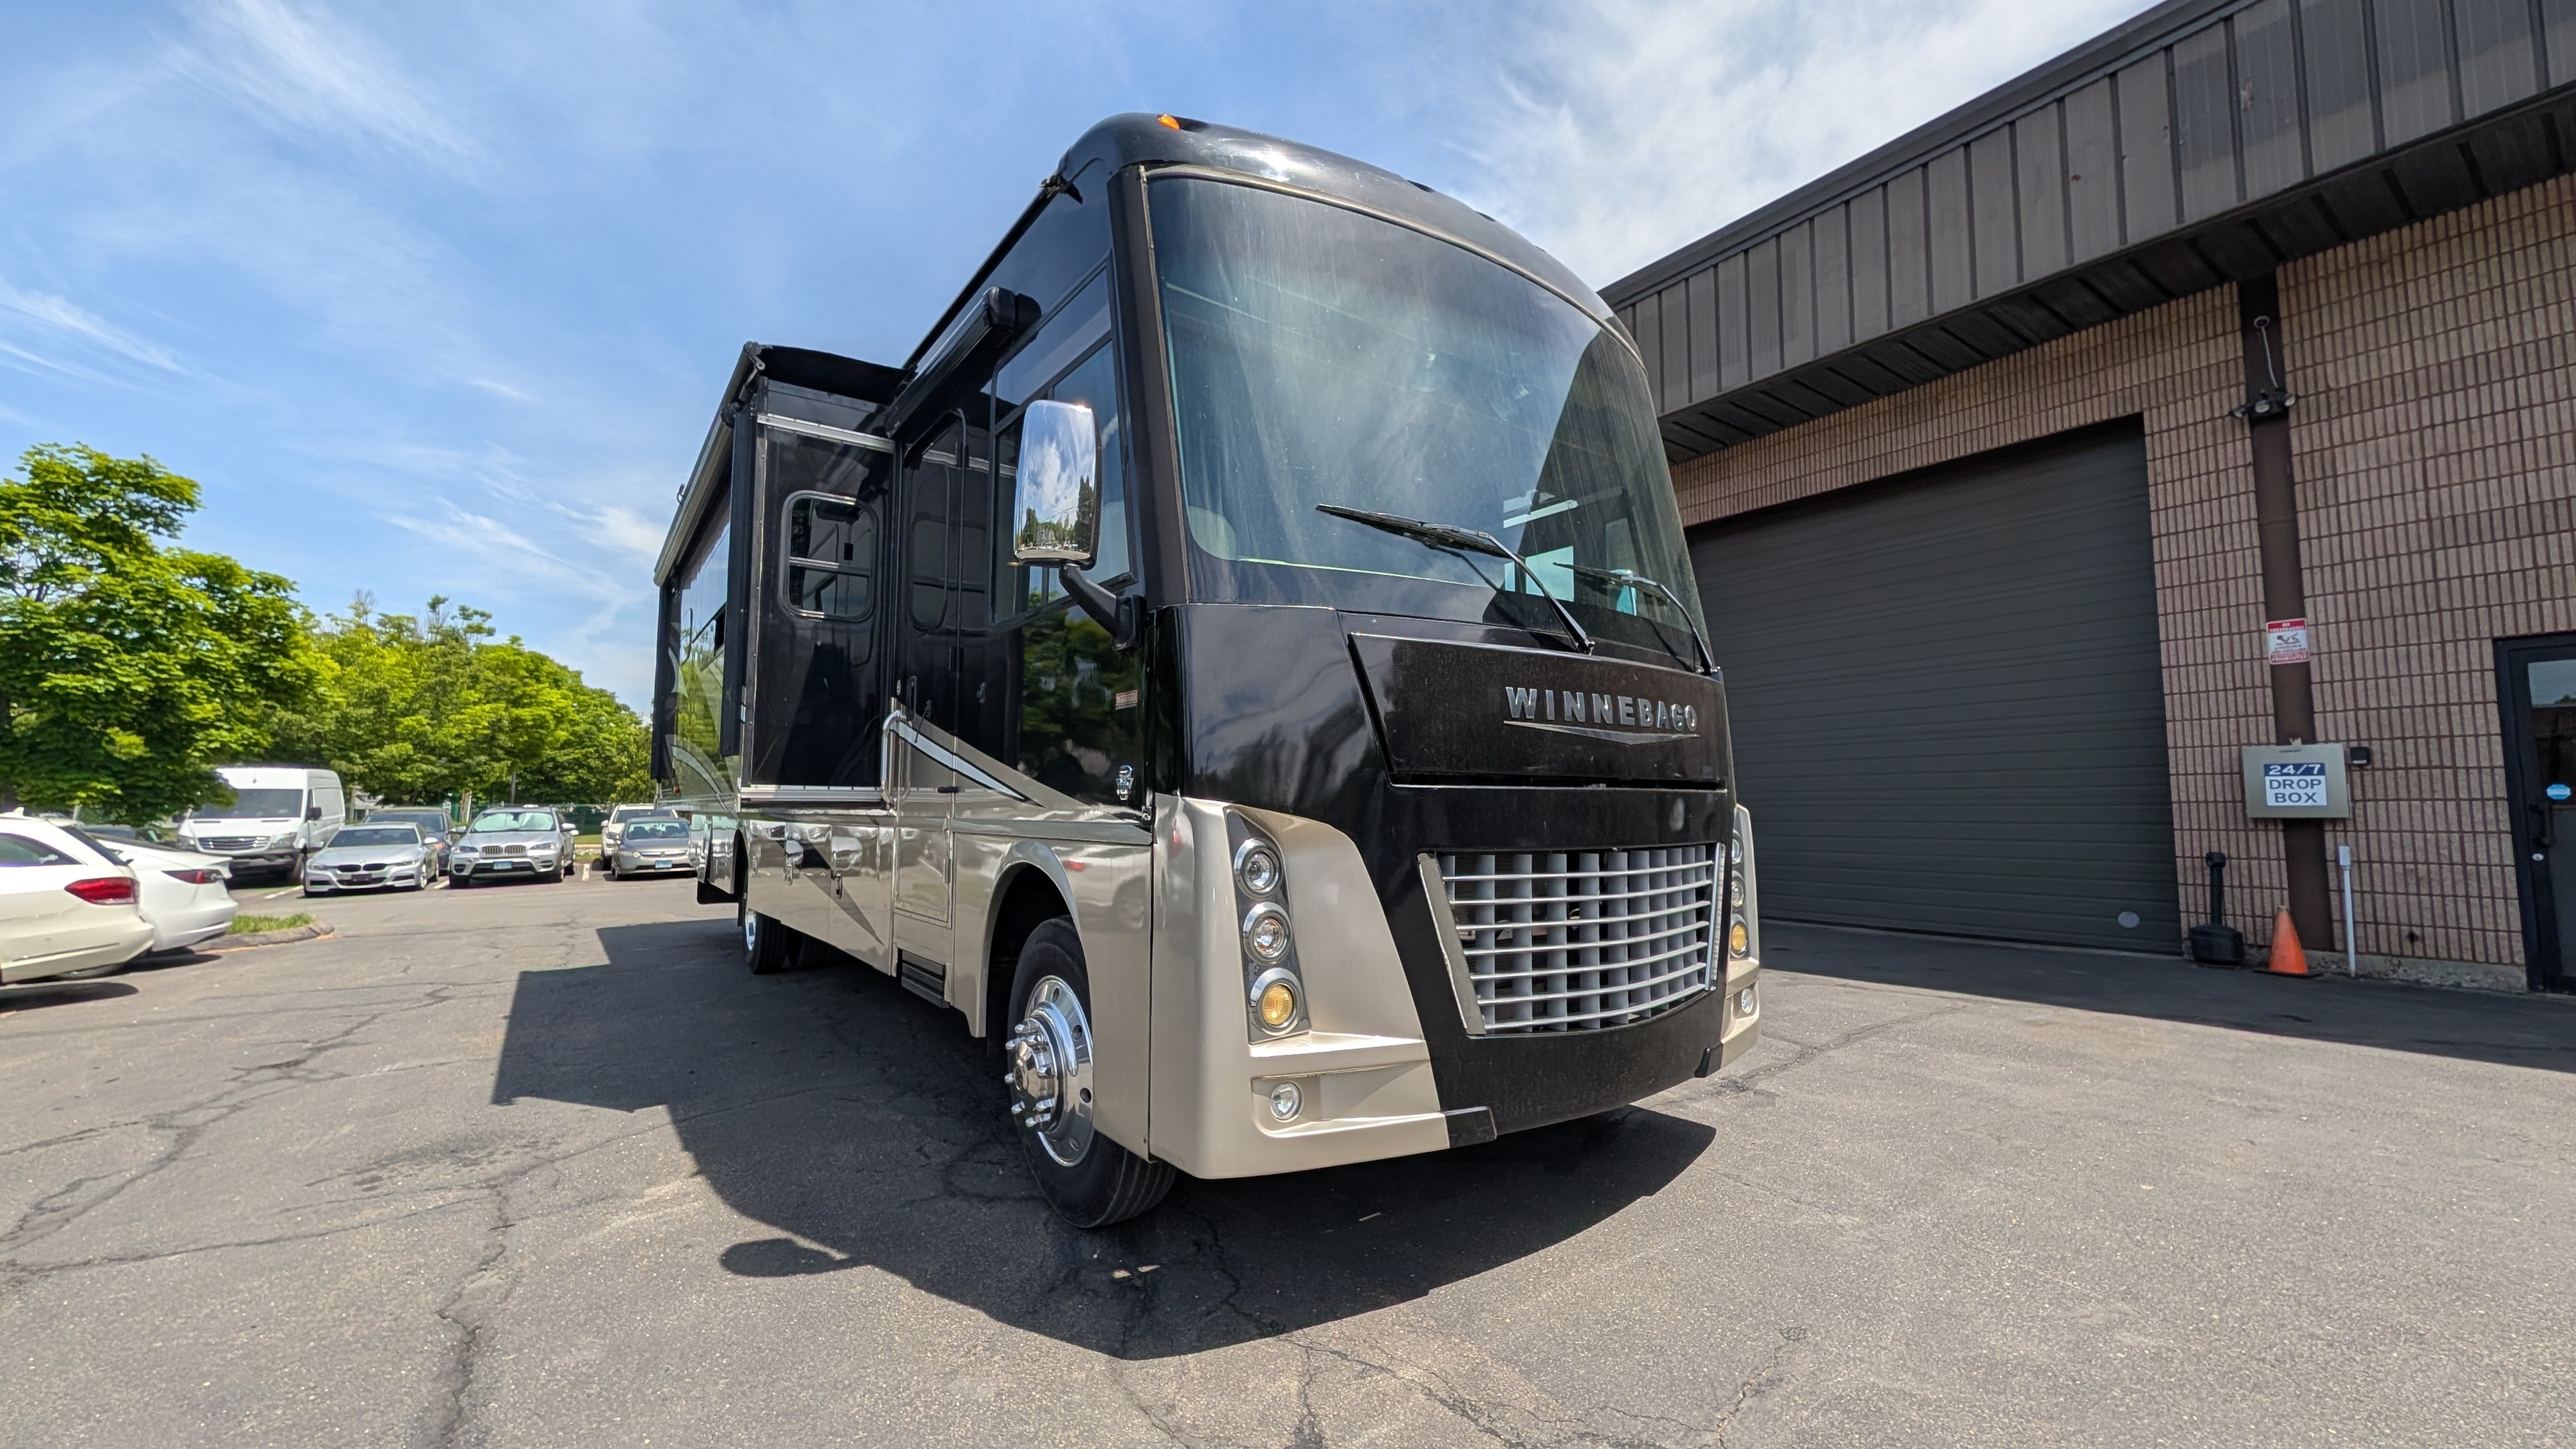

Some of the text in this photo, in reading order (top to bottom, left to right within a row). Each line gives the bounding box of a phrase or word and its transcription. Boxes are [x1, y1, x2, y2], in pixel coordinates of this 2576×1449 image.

[1505, 686, 1698, 732] WINNEBAGO
[2269, 763, 2321, 775] 24/7
[2269, 779, 2322, 790] DROP
[2274, 792, 2317, 803] BOX
